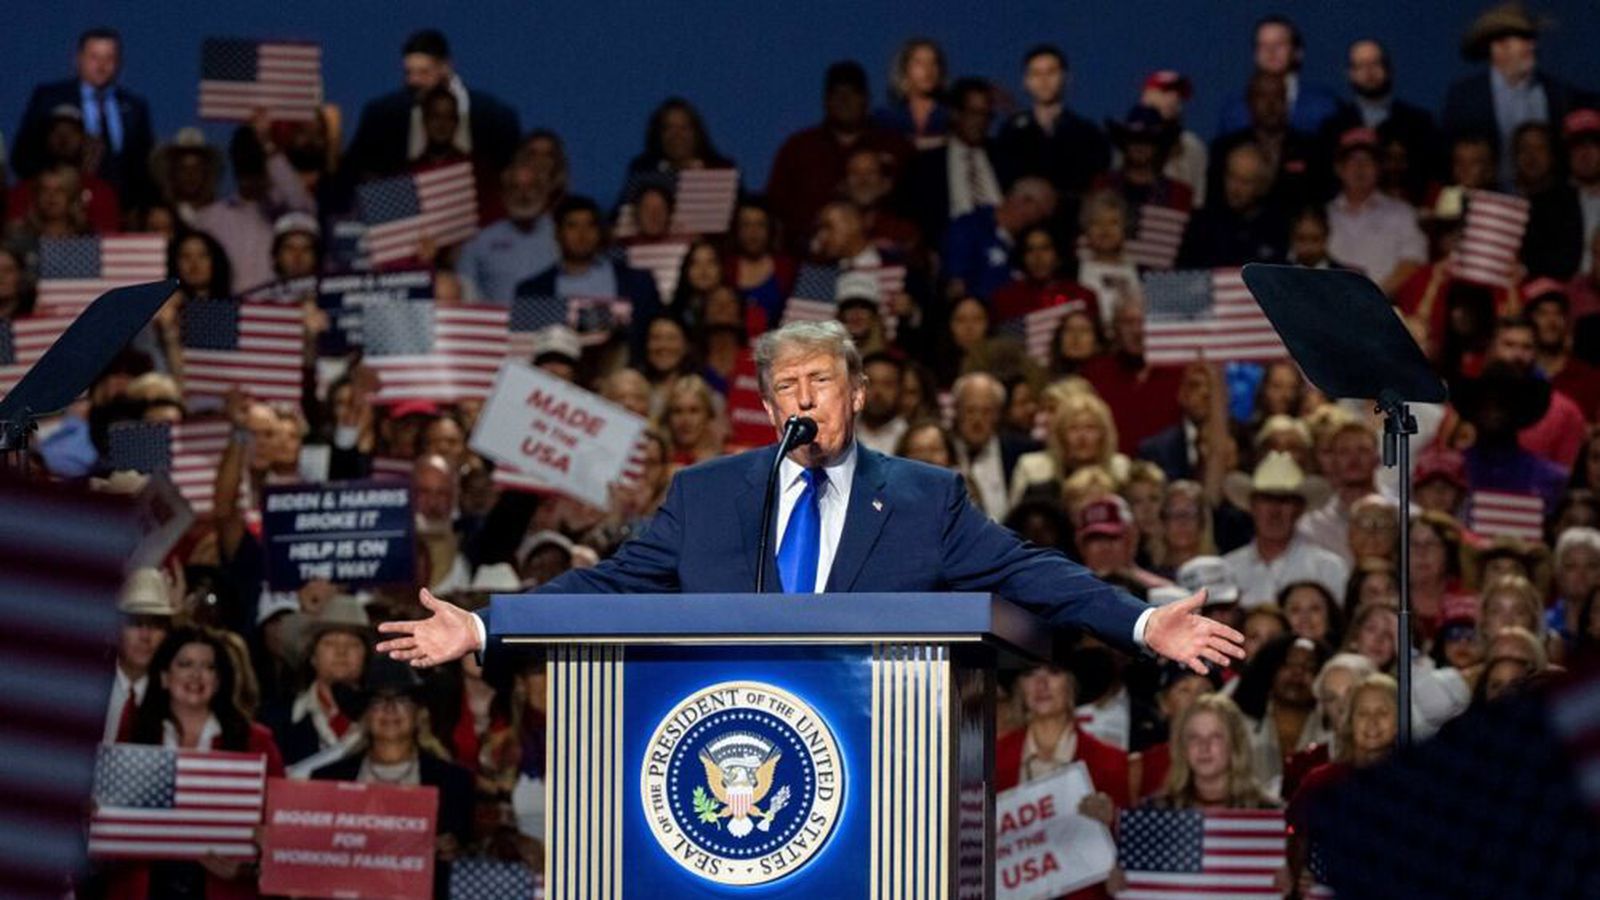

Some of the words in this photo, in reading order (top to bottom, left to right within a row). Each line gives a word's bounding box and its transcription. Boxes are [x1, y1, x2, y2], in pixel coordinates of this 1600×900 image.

[526, 387, 606, 437] MADE
[551, 428, 579, 449] THE
[520, 435, 572, 474] USA
[267, 492, 320, 512] BIDEN
[322, 491, 335, 509] &
[338, 488, 408, 508] HARRIS
[295, 511, 357, 531] BROKE
[359, 510, 379, 528] IT
[288, 540, 335, 560] HELP
[336, 540, 355, 558] IS
[357, 539, 388, 558] ON
[299, 561, 333, 579] THE
[336, 560, 380, 578] WAY
[746, 692, 765, 705] OF
[769, 699, 795, 719] THE
[649, 689, 739, 777] PRESIDENT
[796, 716, 835, 801] UNITED
[651, 783, 663, 811] THE
[273, 810, 333, 827] BIGGER
[335, 813, 428, 831] PAYCHECKS
[658, 815, 673, 834] OF
[997, 794, 1056, 837] ADE
[332, 832, 367, 848] FOR
[760, 812, 827, 875] STATES
[1014, 830, 1046, 850] THE
[272, 849, 349, 867] WORKING
[352, 853, 424, 871] FAMILIES
[673, 834, 722, 876] SEAL
[1002, 852, 1059, 889] USA
